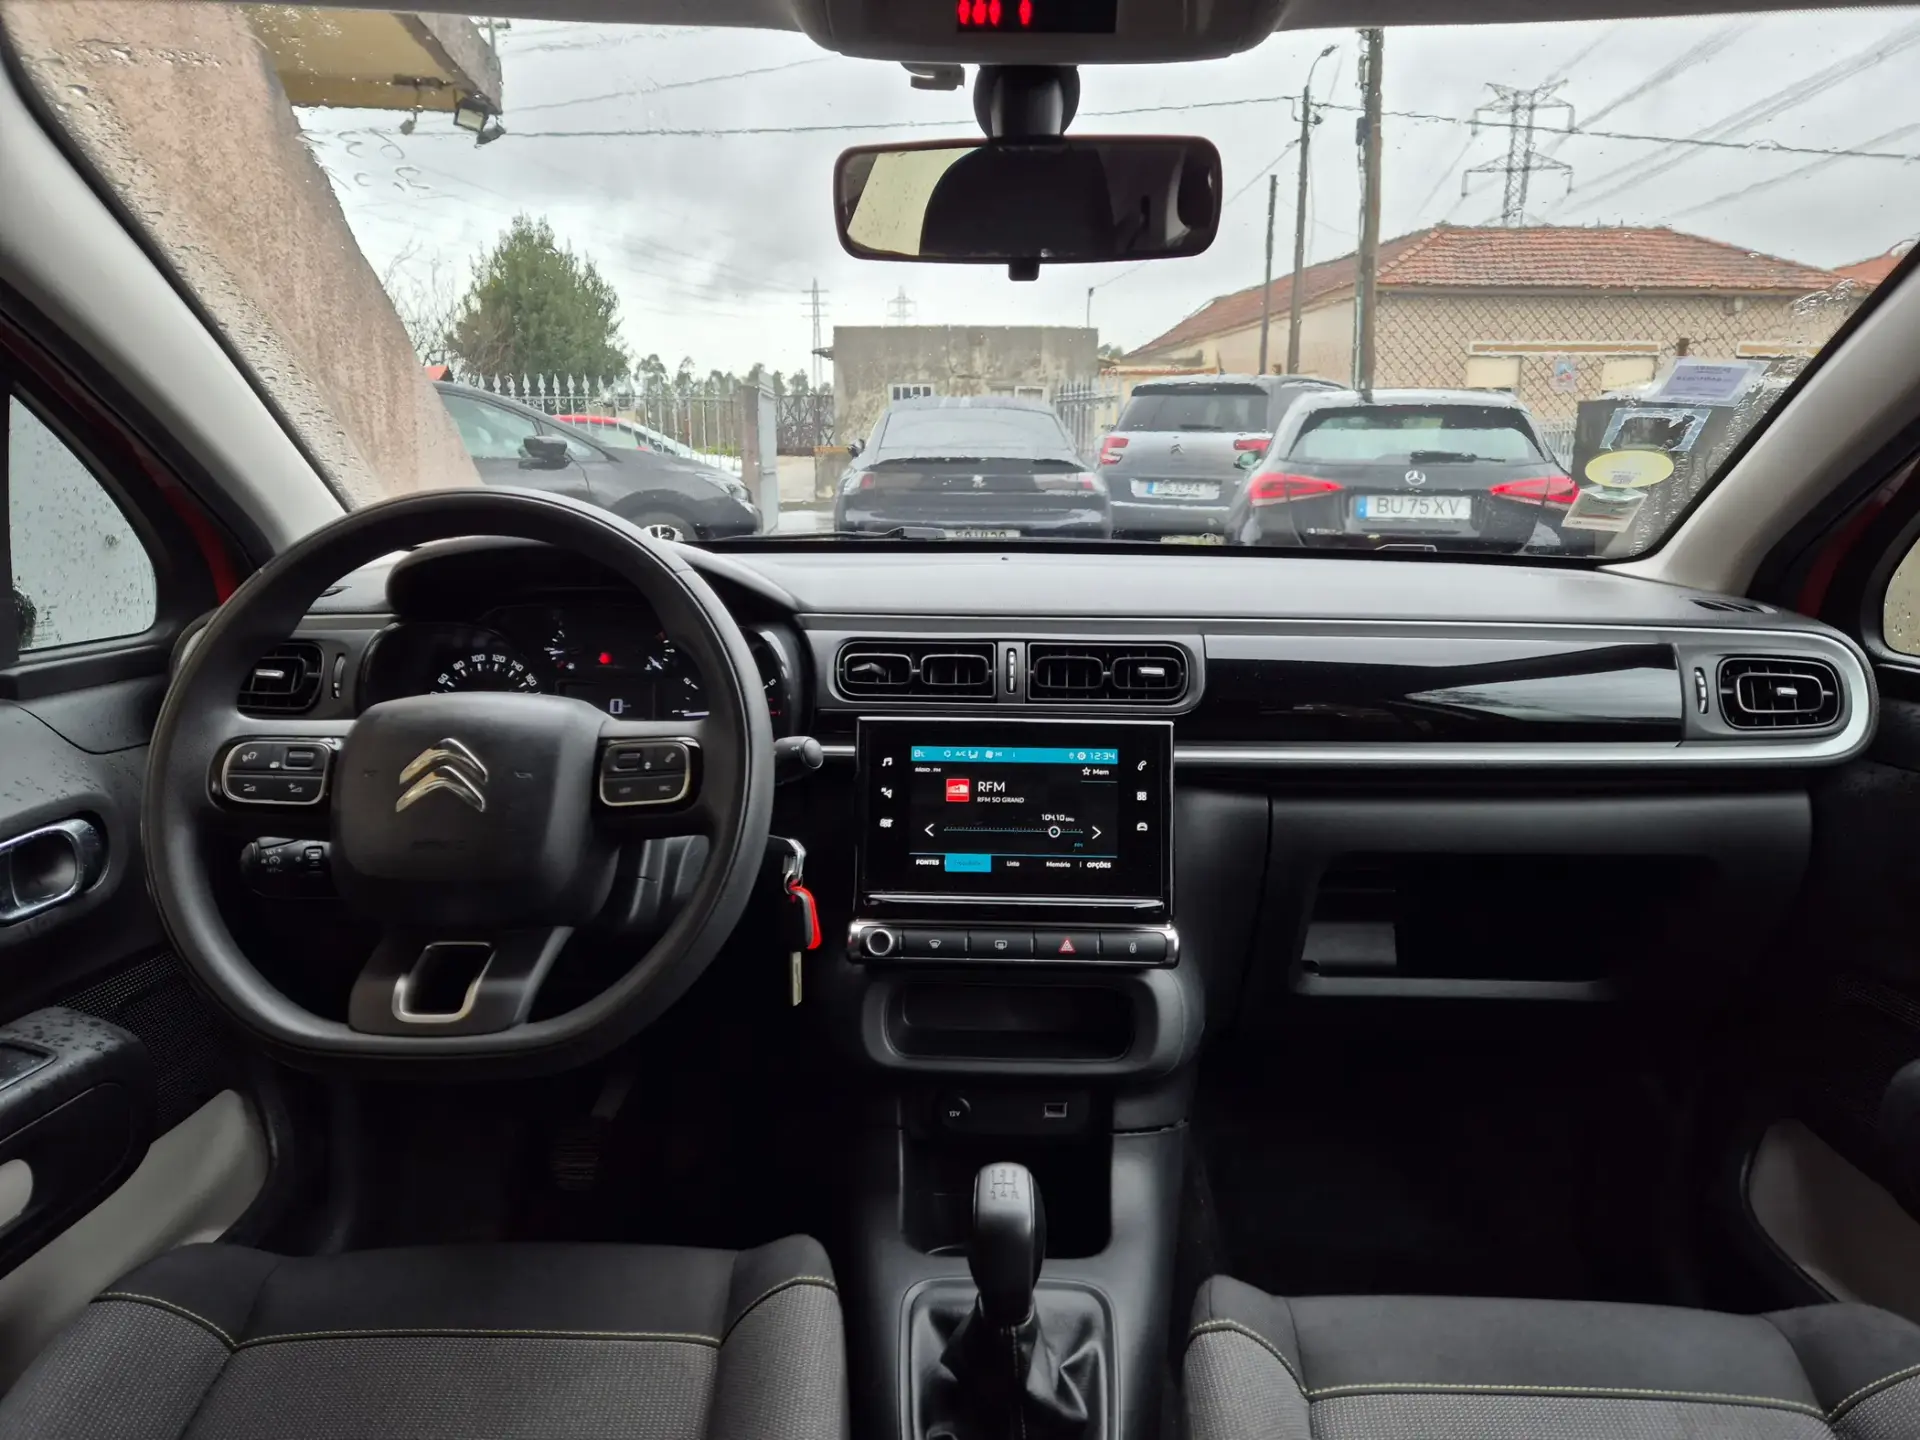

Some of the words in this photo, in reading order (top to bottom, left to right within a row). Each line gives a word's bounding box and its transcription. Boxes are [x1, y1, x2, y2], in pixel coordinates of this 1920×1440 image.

[1376, 497, 1404, 514] BU
[1407, 497, 1430, 515] 75
[1433, 497, 1461, 515] XV
[437, 673, 449, 685] 60
[452, 660, 465, 671] 80
[471, 653, 486, 663] 100
[492, 653, 507, 663] 120
[510, 660, 524, 672] 140
[525, 673, 537, 687] 160
[609, 698, 624, 715] 0
[1089, 751, 1116, 761] 12:34
[1092, 768, 1110, 776] Mem
[977, 781, 1006, 793] RFM
[1002, 796, 1025, 804] GRAND
[915, 858, 940, 867] FONTES
[1086, 861, 1112, 870] OPÇÕES
